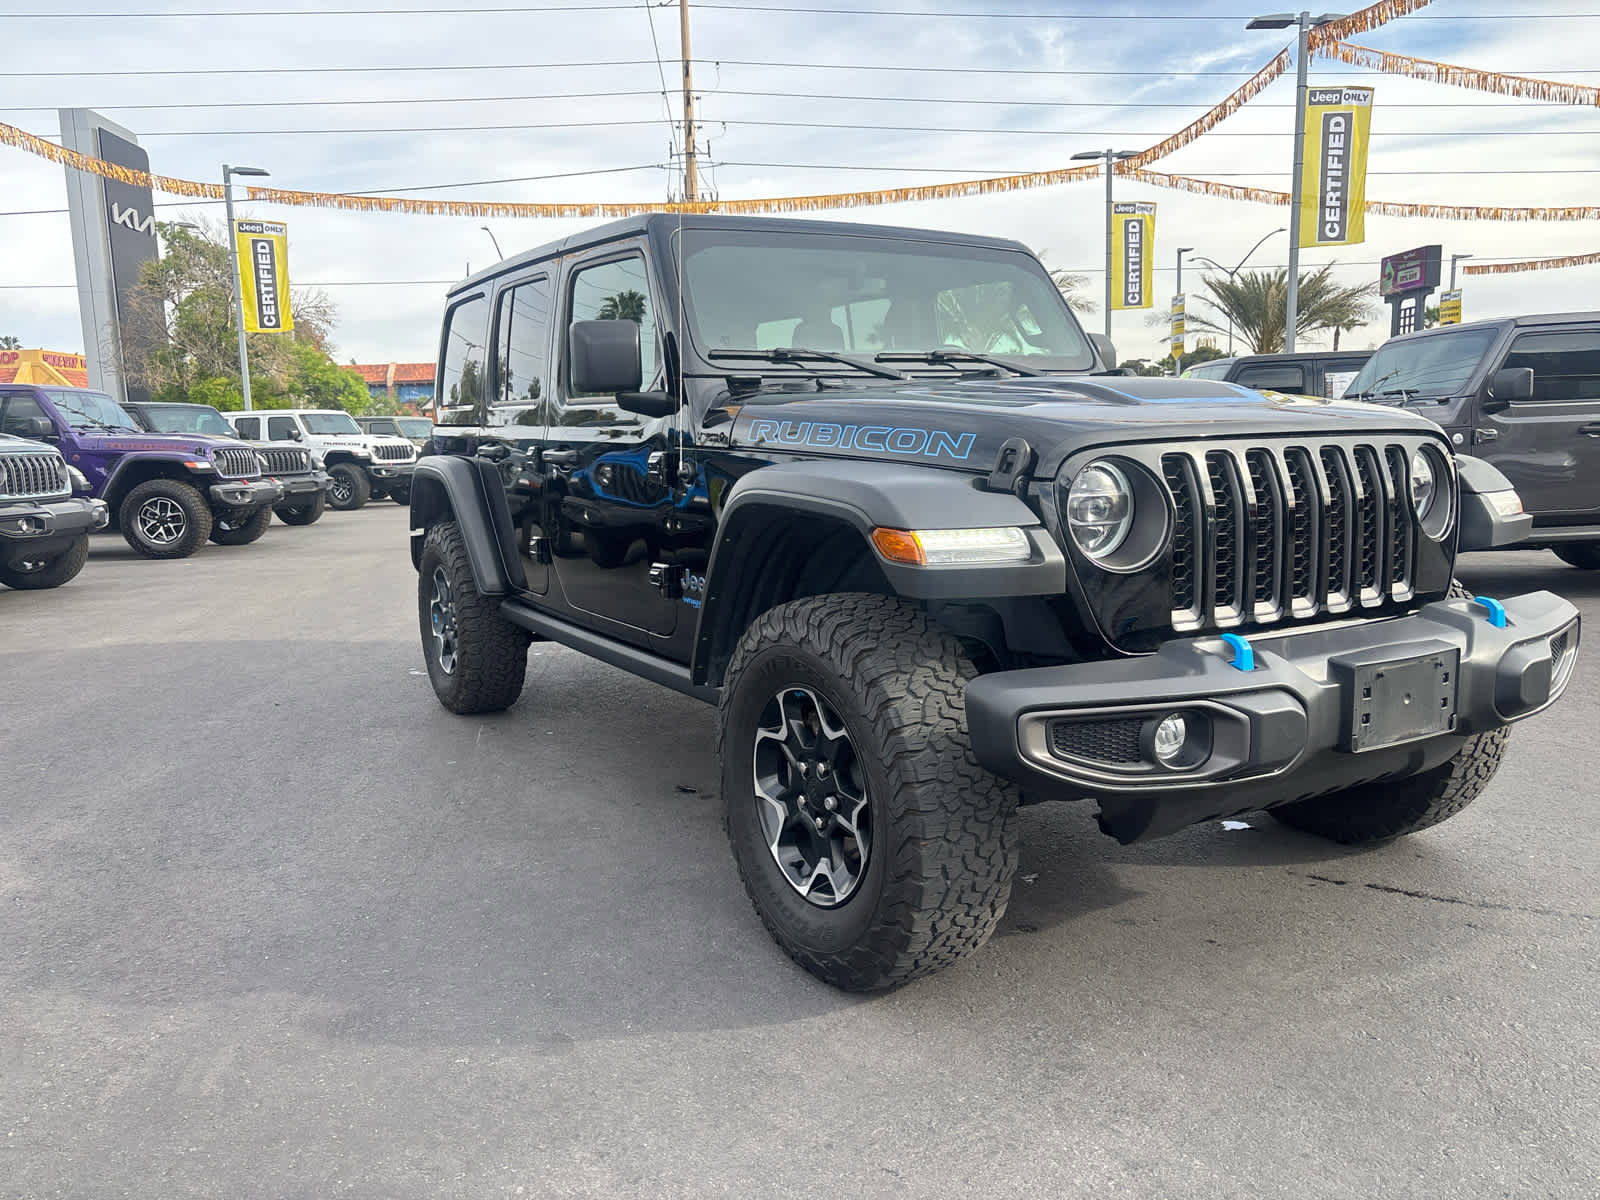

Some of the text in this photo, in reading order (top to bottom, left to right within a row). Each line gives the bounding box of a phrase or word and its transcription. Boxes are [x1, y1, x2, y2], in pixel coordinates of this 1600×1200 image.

[1311, 92, 1369, 103] Jeep ONLY
[1325, 116, 1346, 238] CERTIFIED
[1116, 205, 1153, 213] Jeep ONLY
[240, 223, 284, 233] Jeep ONLY
[1128, 221, 1140, 304] CERTIFIED
[257, 242, 276, 326] CERTIFIED
[749, 419, 976, 459] RUBICON
[680, 568, 705, 592] Jee
